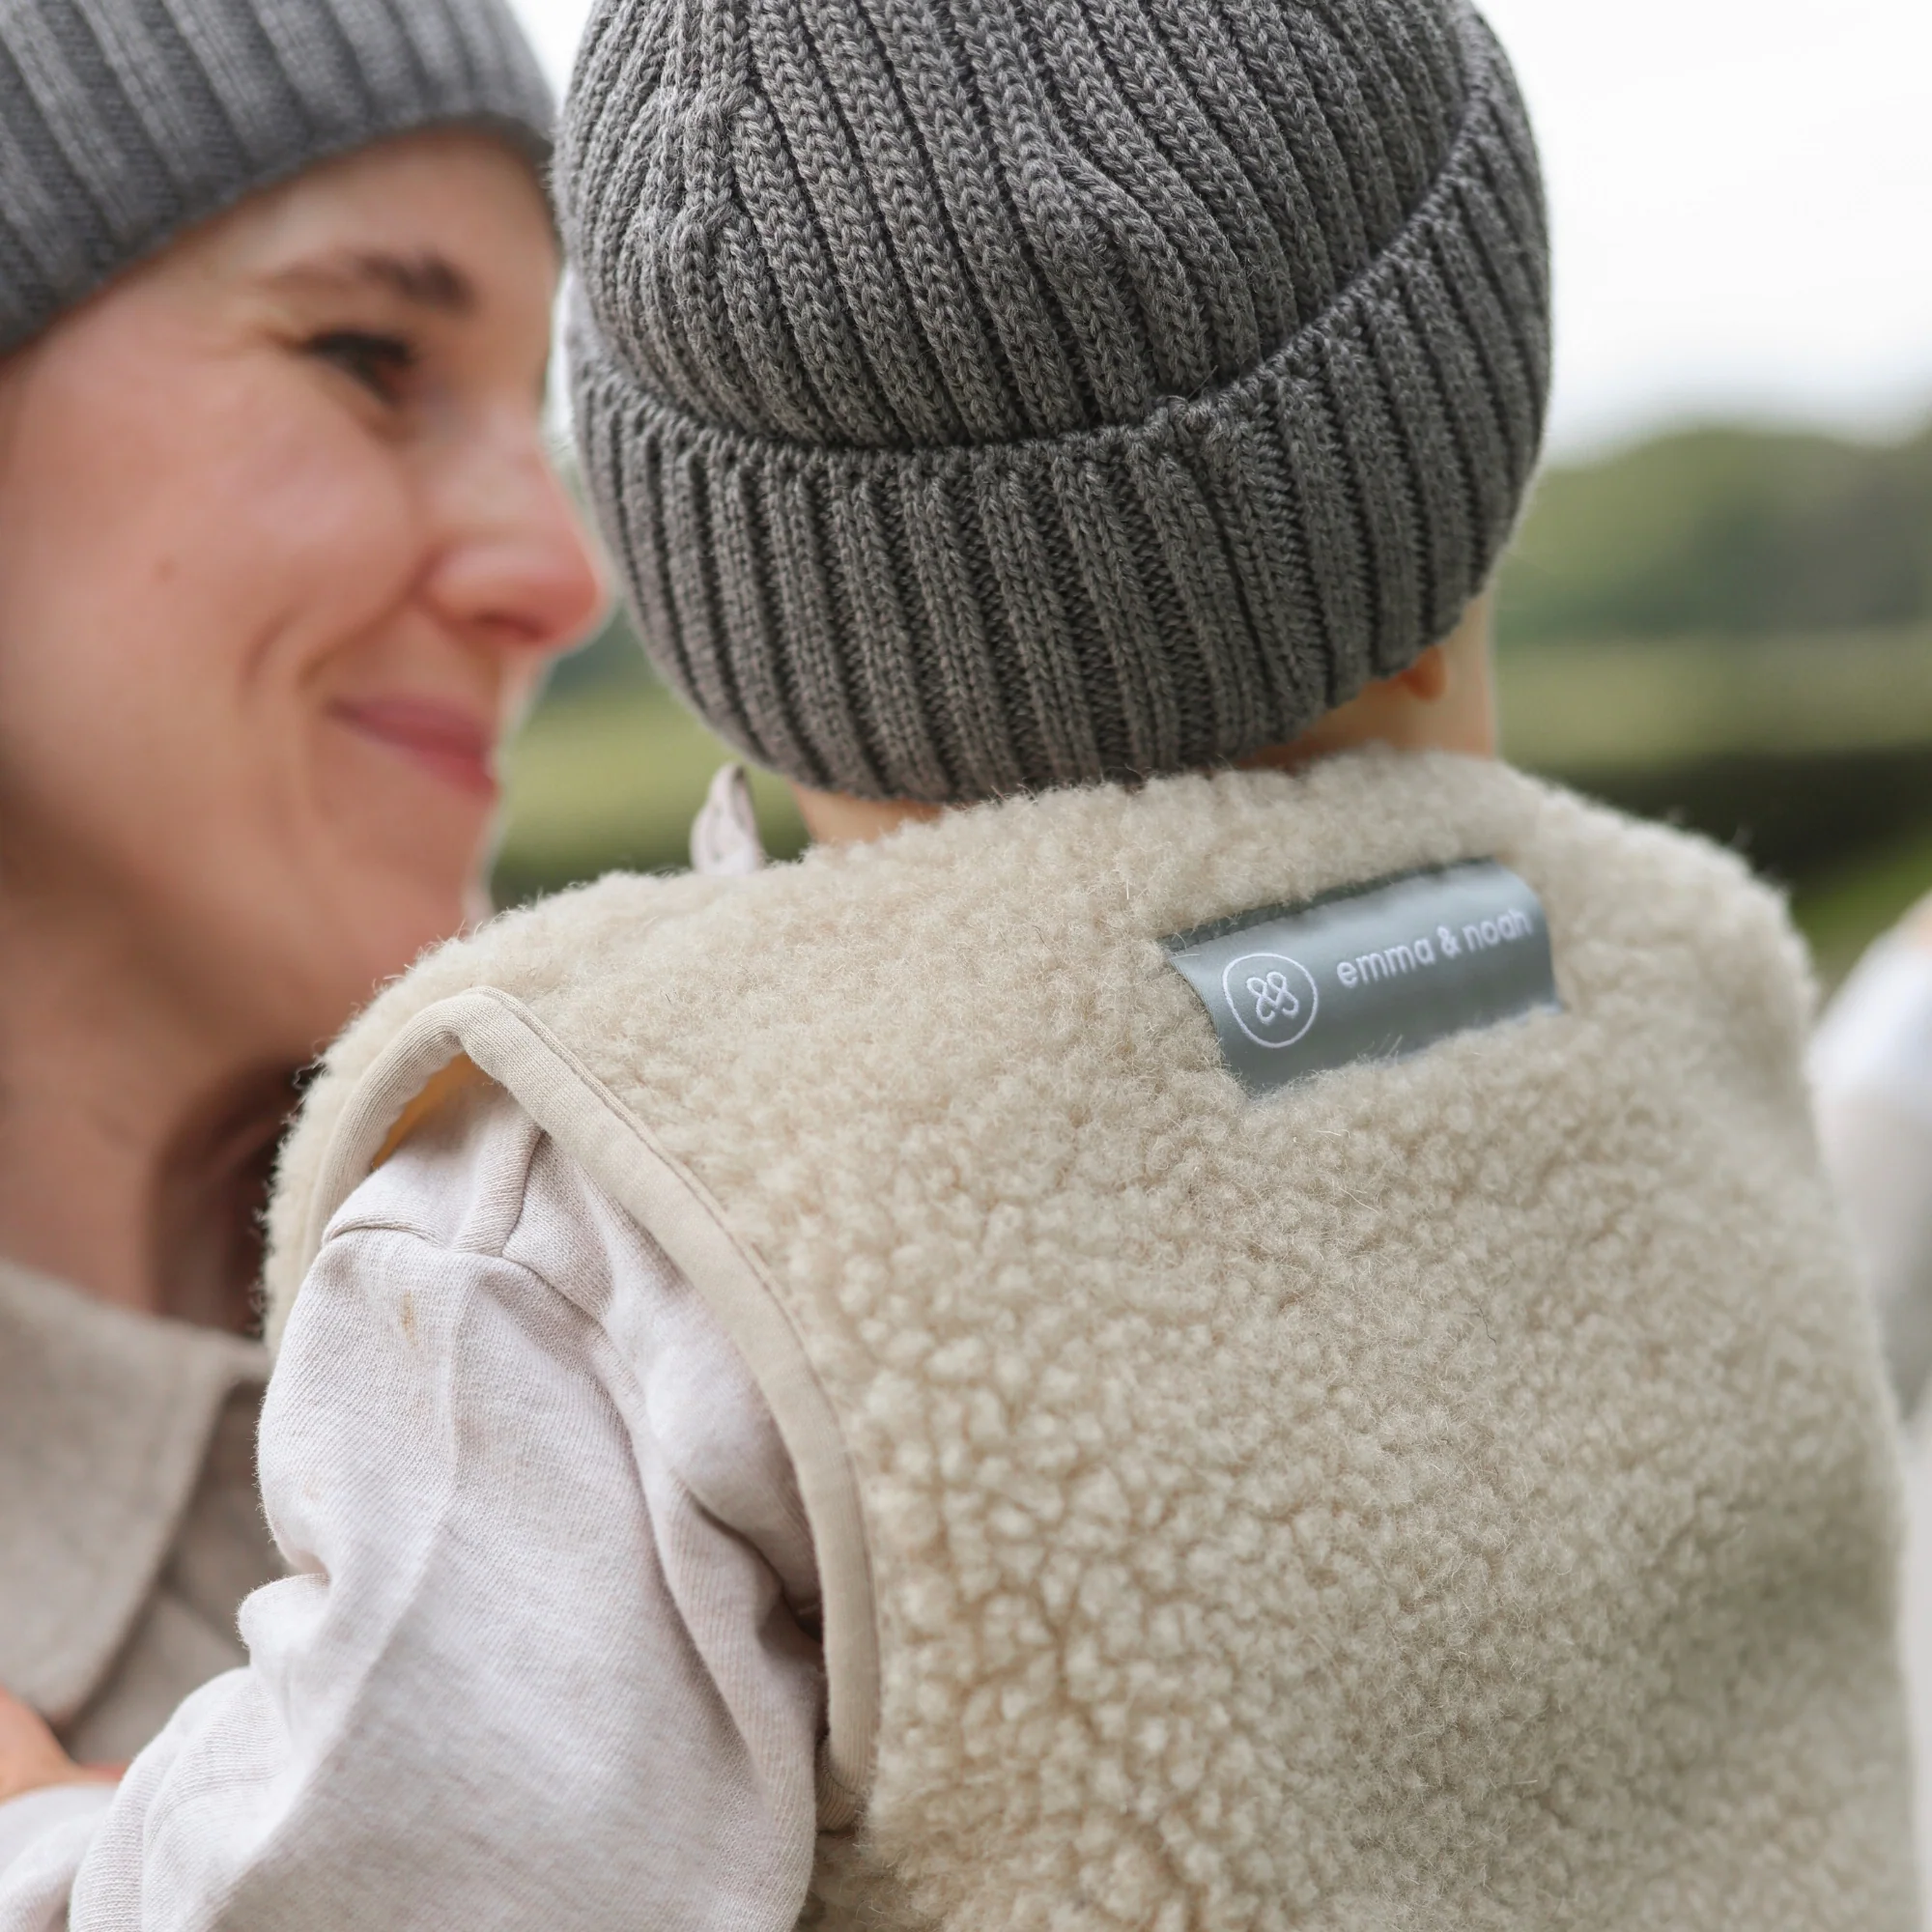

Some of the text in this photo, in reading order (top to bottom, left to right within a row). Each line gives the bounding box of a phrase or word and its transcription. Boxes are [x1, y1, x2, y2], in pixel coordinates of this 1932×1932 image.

[1337, 908, 1533, 988] emma & noah
